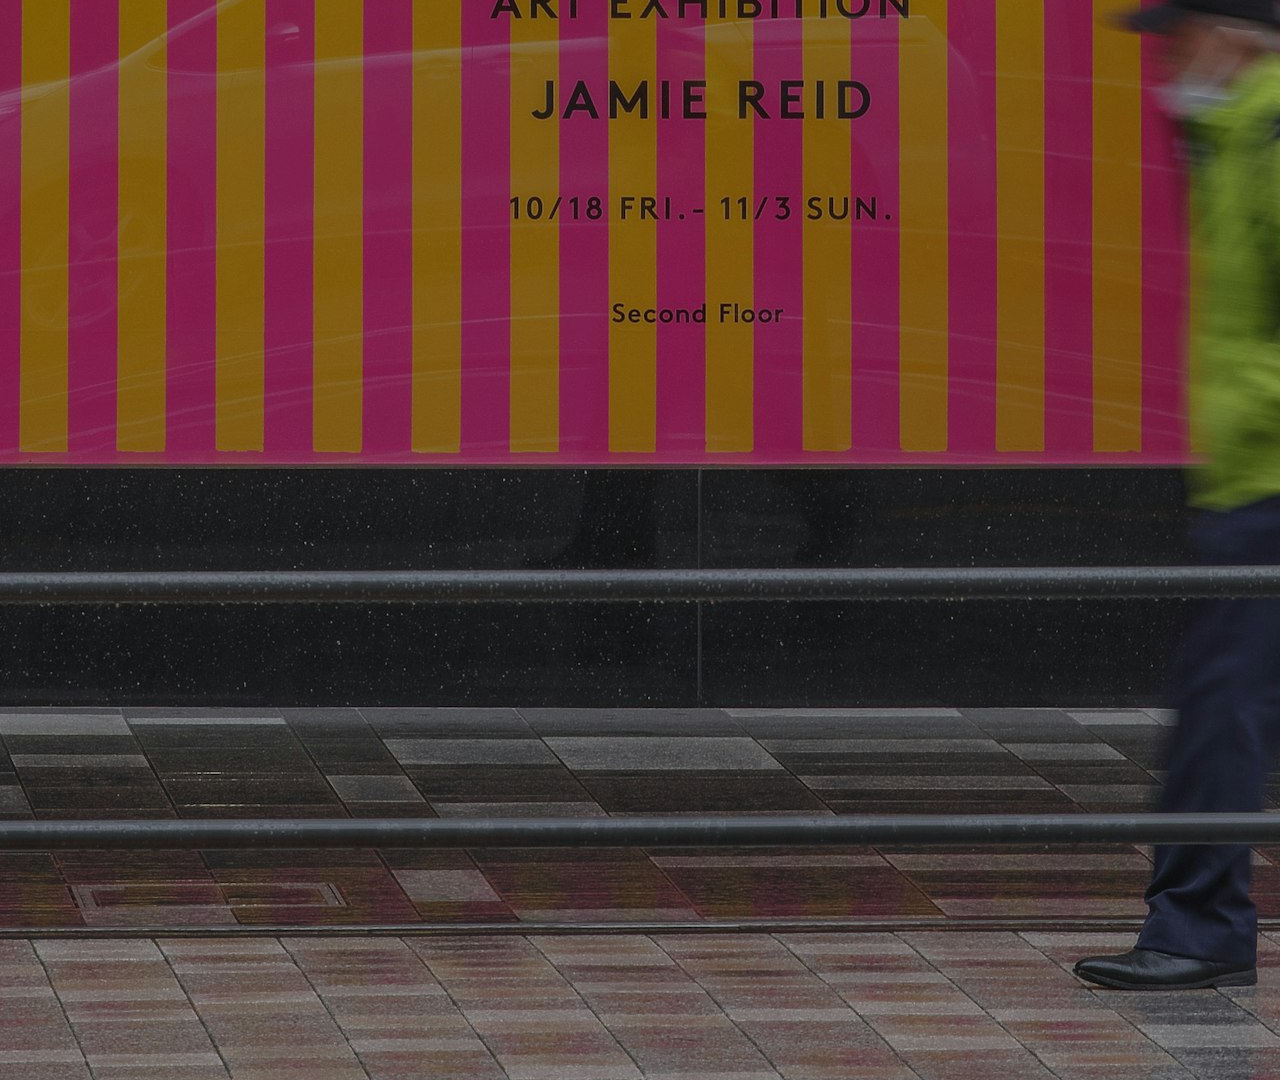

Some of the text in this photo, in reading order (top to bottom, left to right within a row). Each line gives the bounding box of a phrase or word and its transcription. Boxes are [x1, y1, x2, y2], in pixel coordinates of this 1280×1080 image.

[531, 80, 871, 120] JAMIE REID
[510, 196, 603, 221] 10/18
[720, 196, 791, 221] 11/3
[807, 196, 891, 221] SUN.
[612, 303, 784, 324] Second Floor
